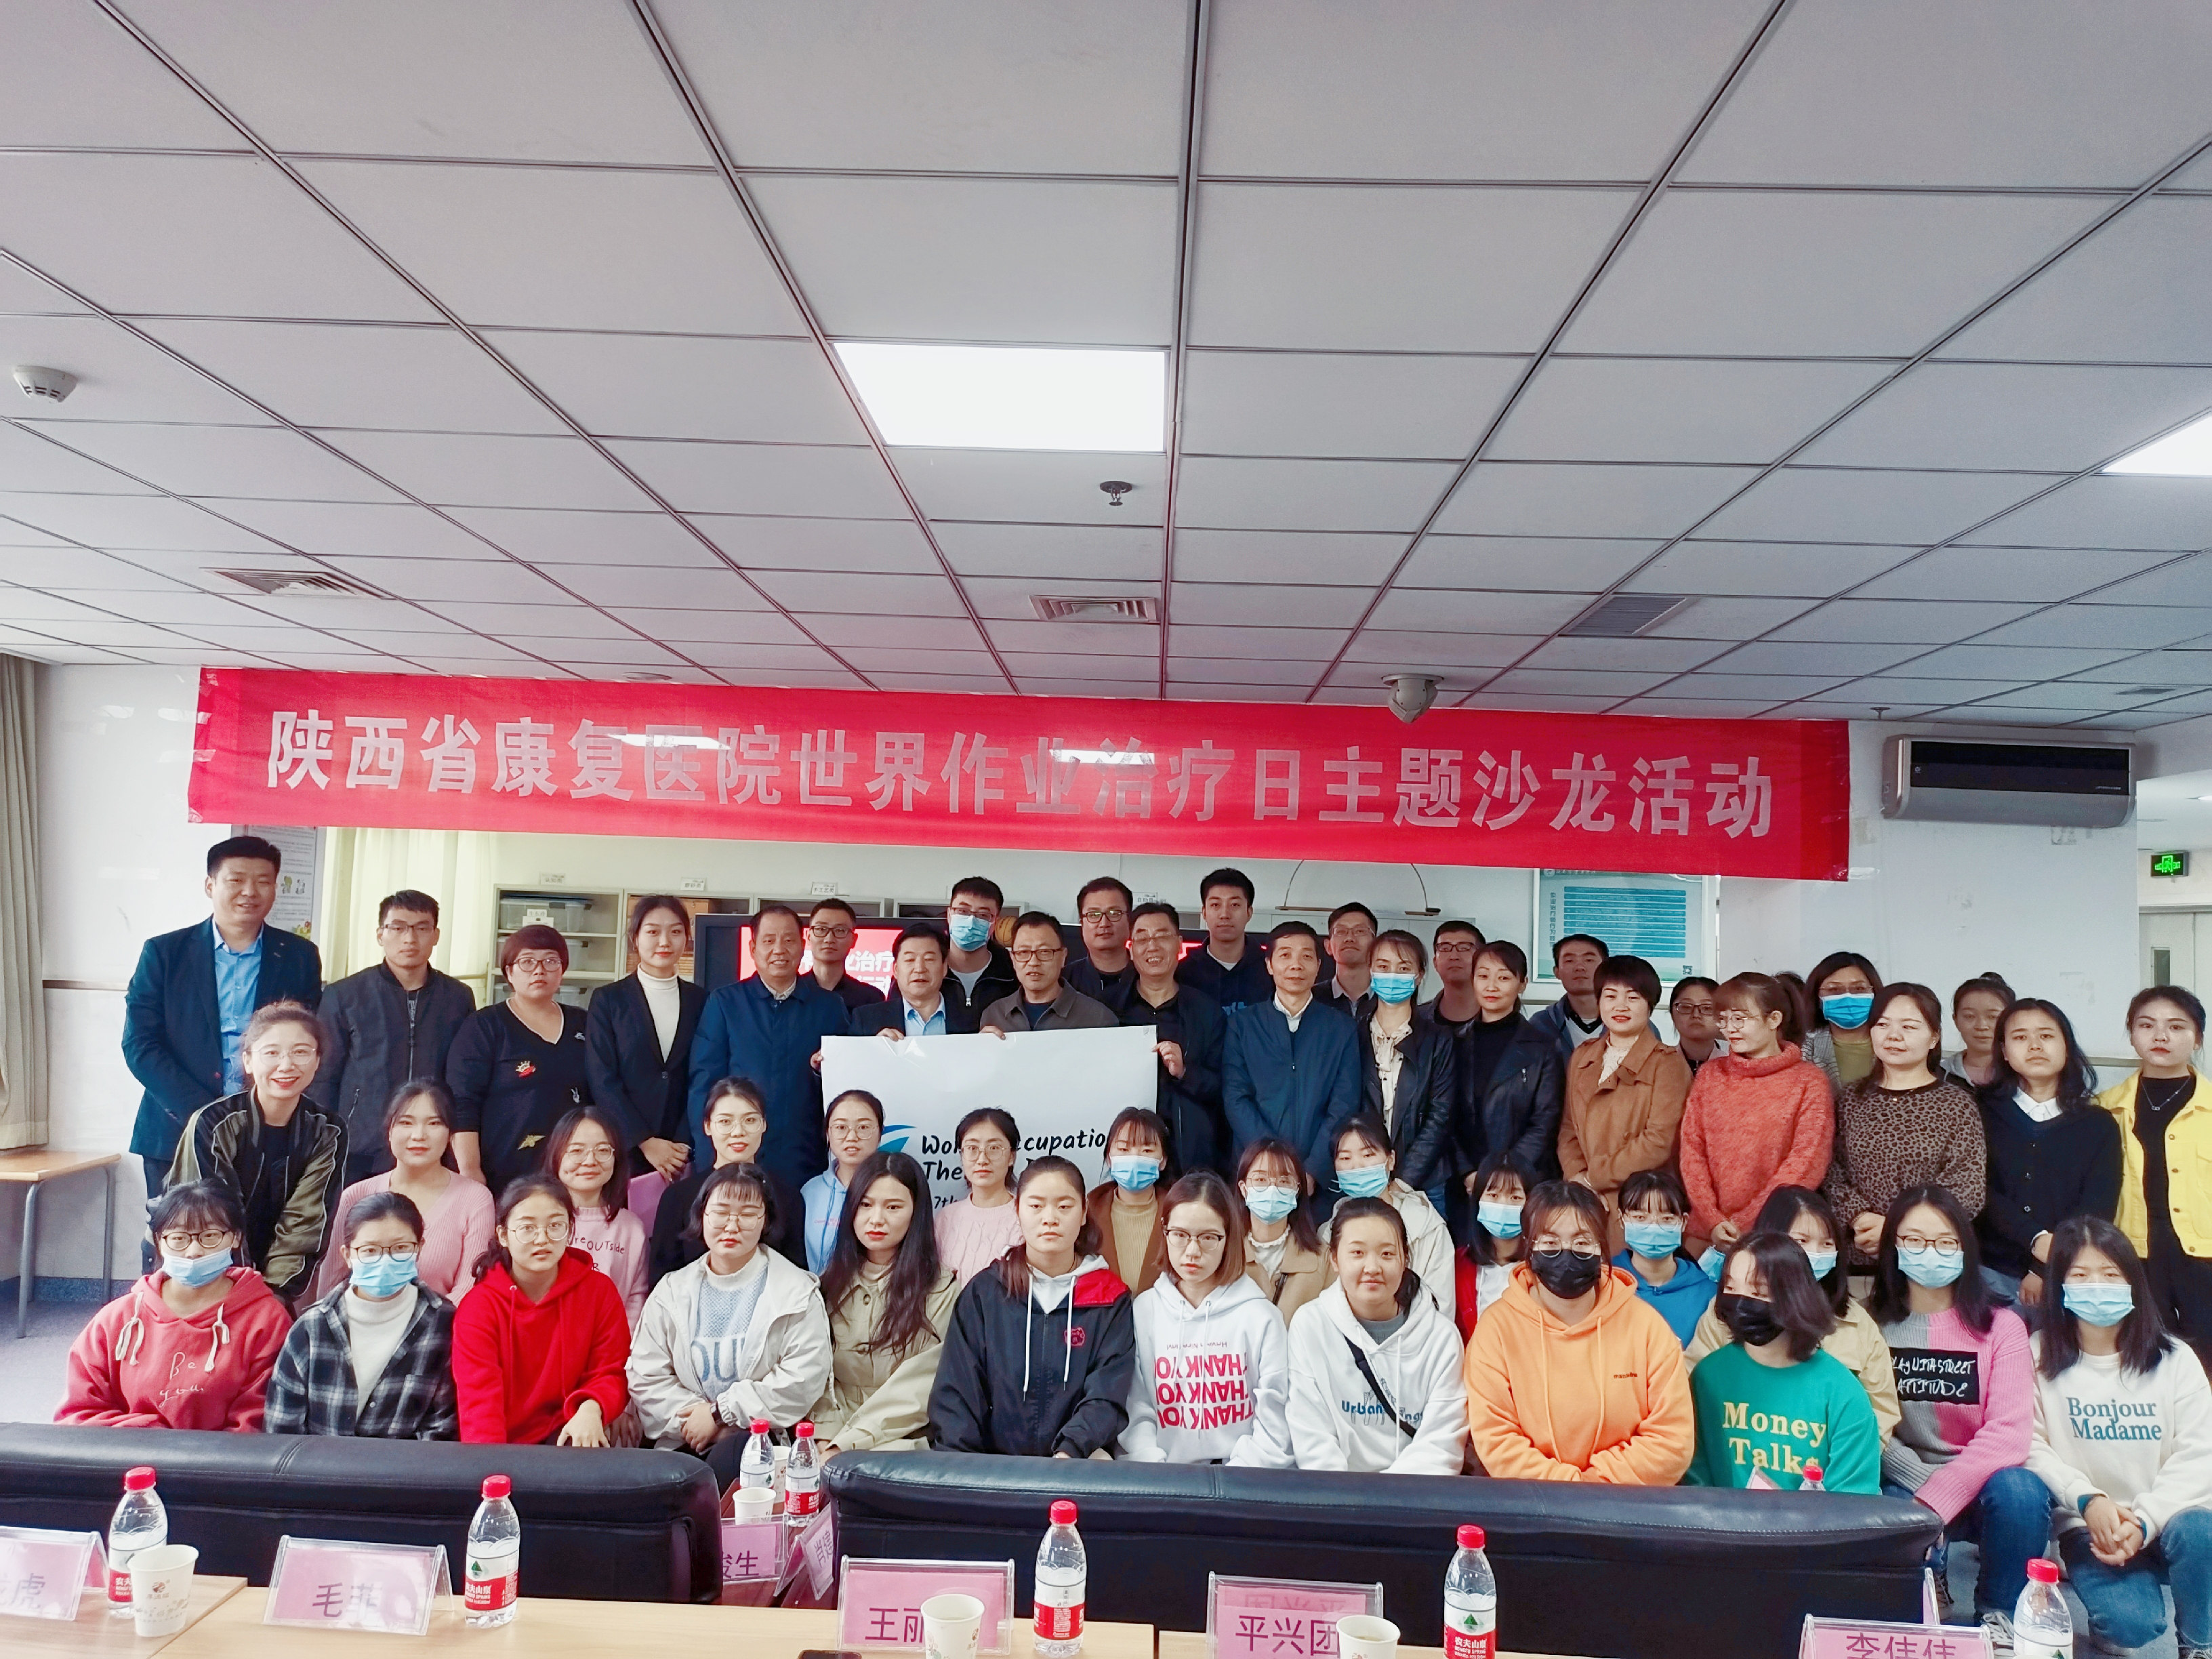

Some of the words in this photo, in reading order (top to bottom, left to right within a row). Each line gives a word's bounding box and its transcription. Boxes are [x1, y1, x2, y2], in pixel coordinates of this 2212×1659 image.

[267, 709, 1772, 839] 陕西省康复医院世界作业治疗日主题沙龙活动
[169, 1351, 197, 1380] Be
[2066, 1396, 2156, 1423] Bonjour
[1722, 1401, 1826, 1448] Money
[2069, 1417, 2162, 1440] Madame
[1235, 1615, 1340, 1658] 平兴团
[1455, 1636, 1487, 1649] 农夫山泉
